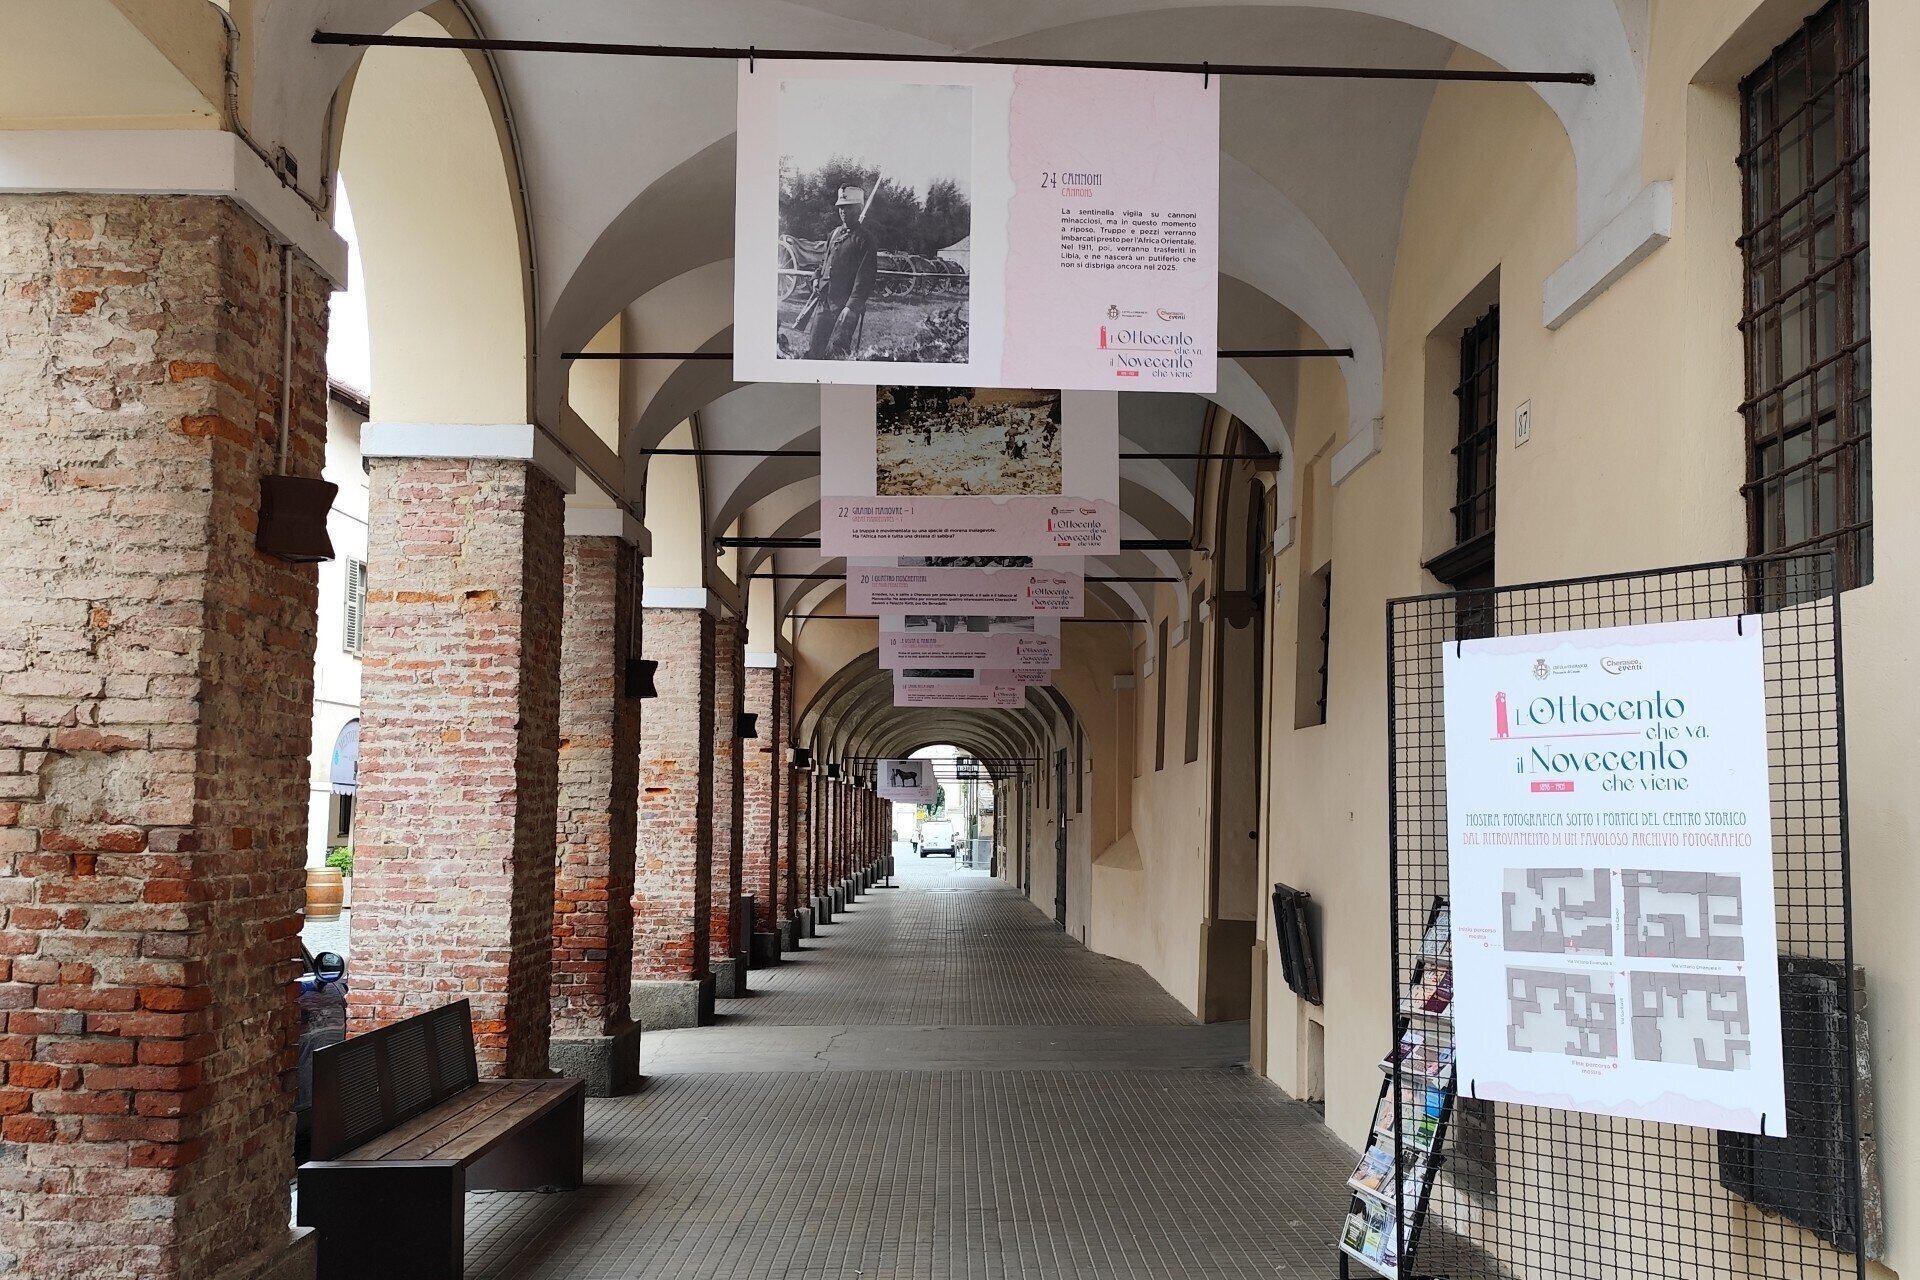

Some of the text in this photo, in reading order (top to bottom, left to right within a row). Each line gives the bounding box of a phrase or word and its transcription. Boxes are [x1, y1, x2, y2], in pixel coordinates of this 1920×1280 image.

[1041, 172, 1102, 188] 24 CANNONI
[1062, 188, 1092, 197] CANNONS
[1104, 253, 1132, 261] nascerà
[1149, 255, 1179, 263] putiferio
[1174, 347, 1189, 355] che
[1118, 354, 1193, 368] Novecento
[1152, 370, 1192, 378] che viene
[1519, 411, 1527, 437] 87
[839, 507, 848, 517] 22
[861, 575, 869, 583] 20
[1607, 659, 1638, 667] Cherasco
[1618, 663, 1642, 672] eventi
[1646, 722, 1709, 739] che va.
[1517, 742, 1687, 773] il Novecento
[1602, 774, 1689, 791] che viene
[1466, 812, 1746, 826] MOSTRA FOTOGRAFICA SOTTO I PORTICI DEL CENTRO STORICO
[1463, 832, 1752, 846] DAL RITROVAMENTO DI UN FAVOLOSO ARCHIVIO FOTOGRAFICO
